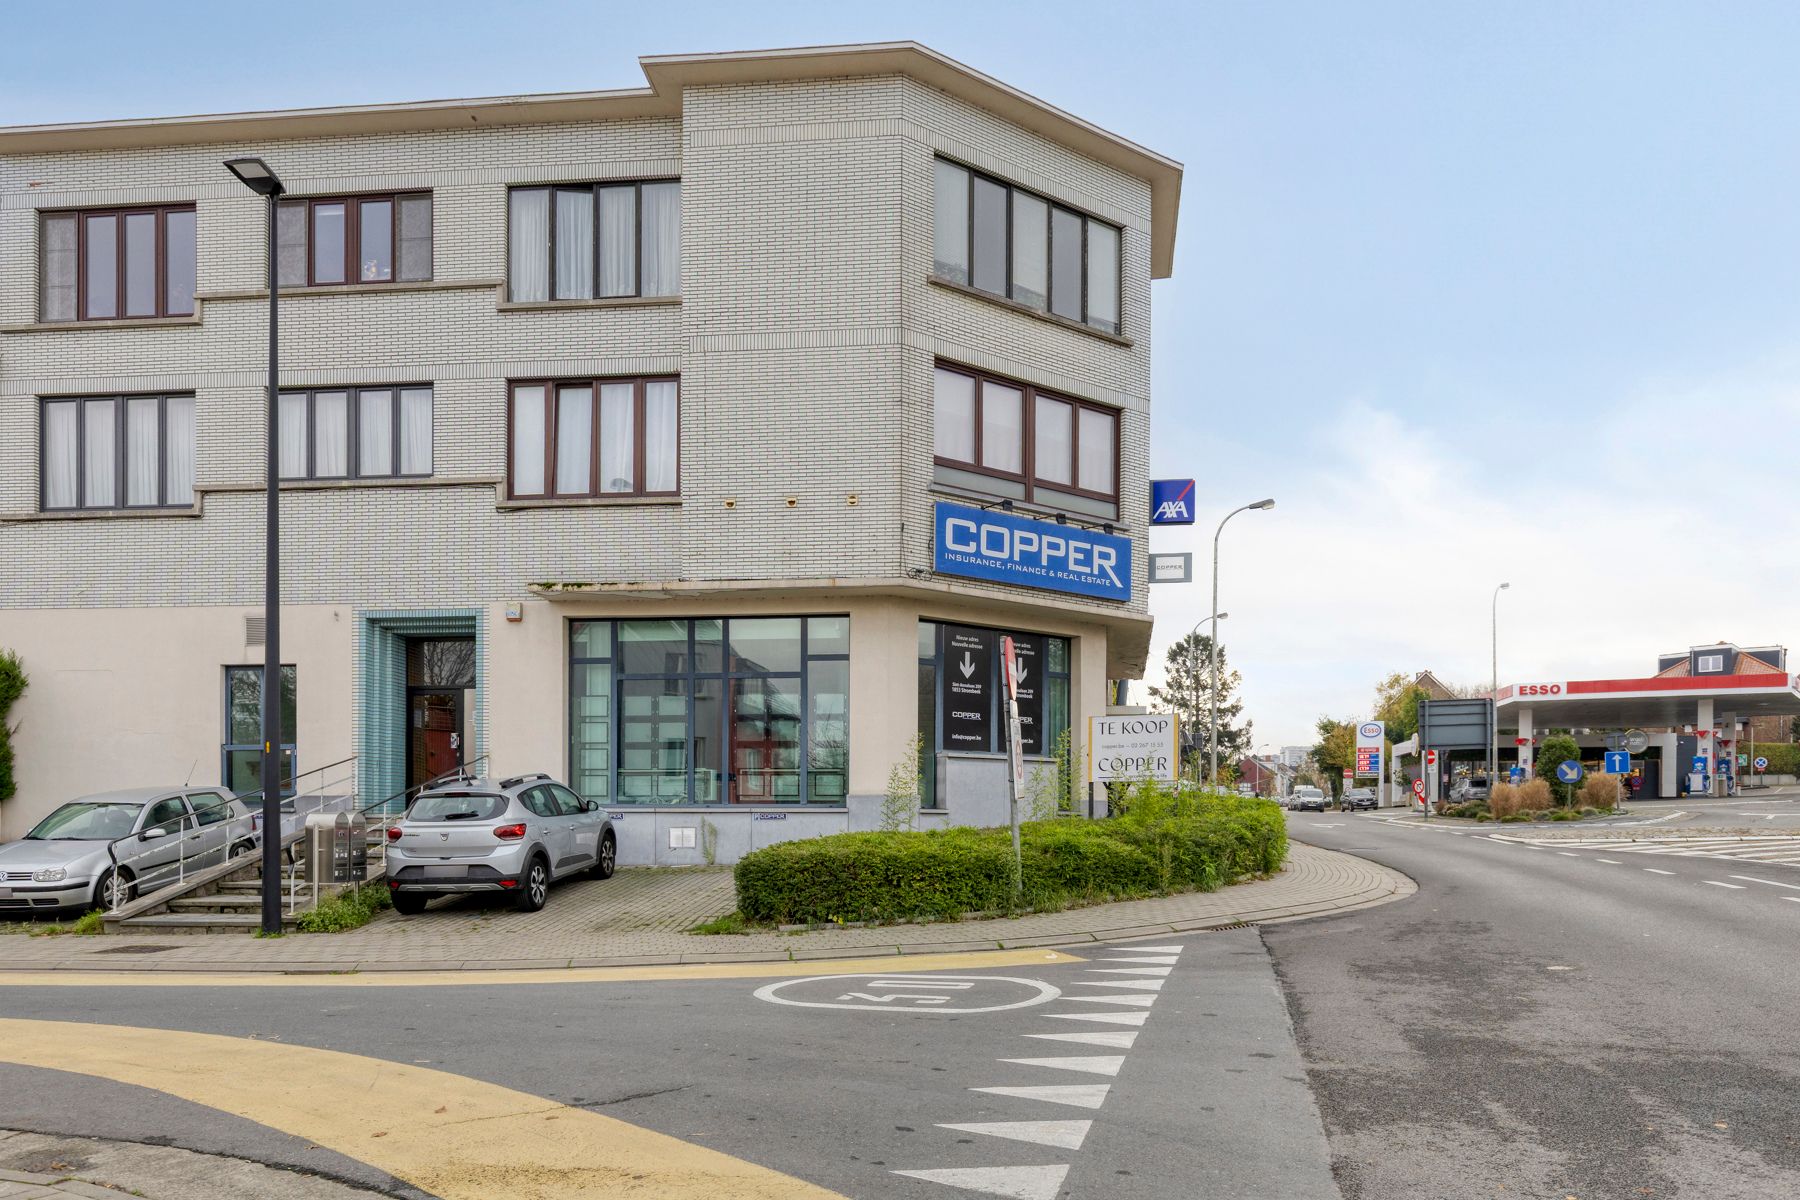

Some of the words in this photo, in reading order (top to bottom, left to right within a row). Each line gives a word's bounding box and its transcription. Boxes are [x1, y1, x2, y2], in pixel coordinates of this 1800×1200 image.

[1153, 501, 1188, 519] AXA
[946, 517, 1123, 588] COPPER
[945, 553, 1004, 570] INSURANCE,
[1007, 563, 1047, 576] FINANCE
[1058, 571, 1079, 581] REAL
[1081, 575, 1111, 586] ESTATE
[1519, 684, 1561, 695] ESSO
[952, 711, 982, 720] COPPER
[1098, 721, 1116, 735] TE
[1122, 720, 1168, 734] KOOP
[1098, 757, 1167, 771] COPPER
